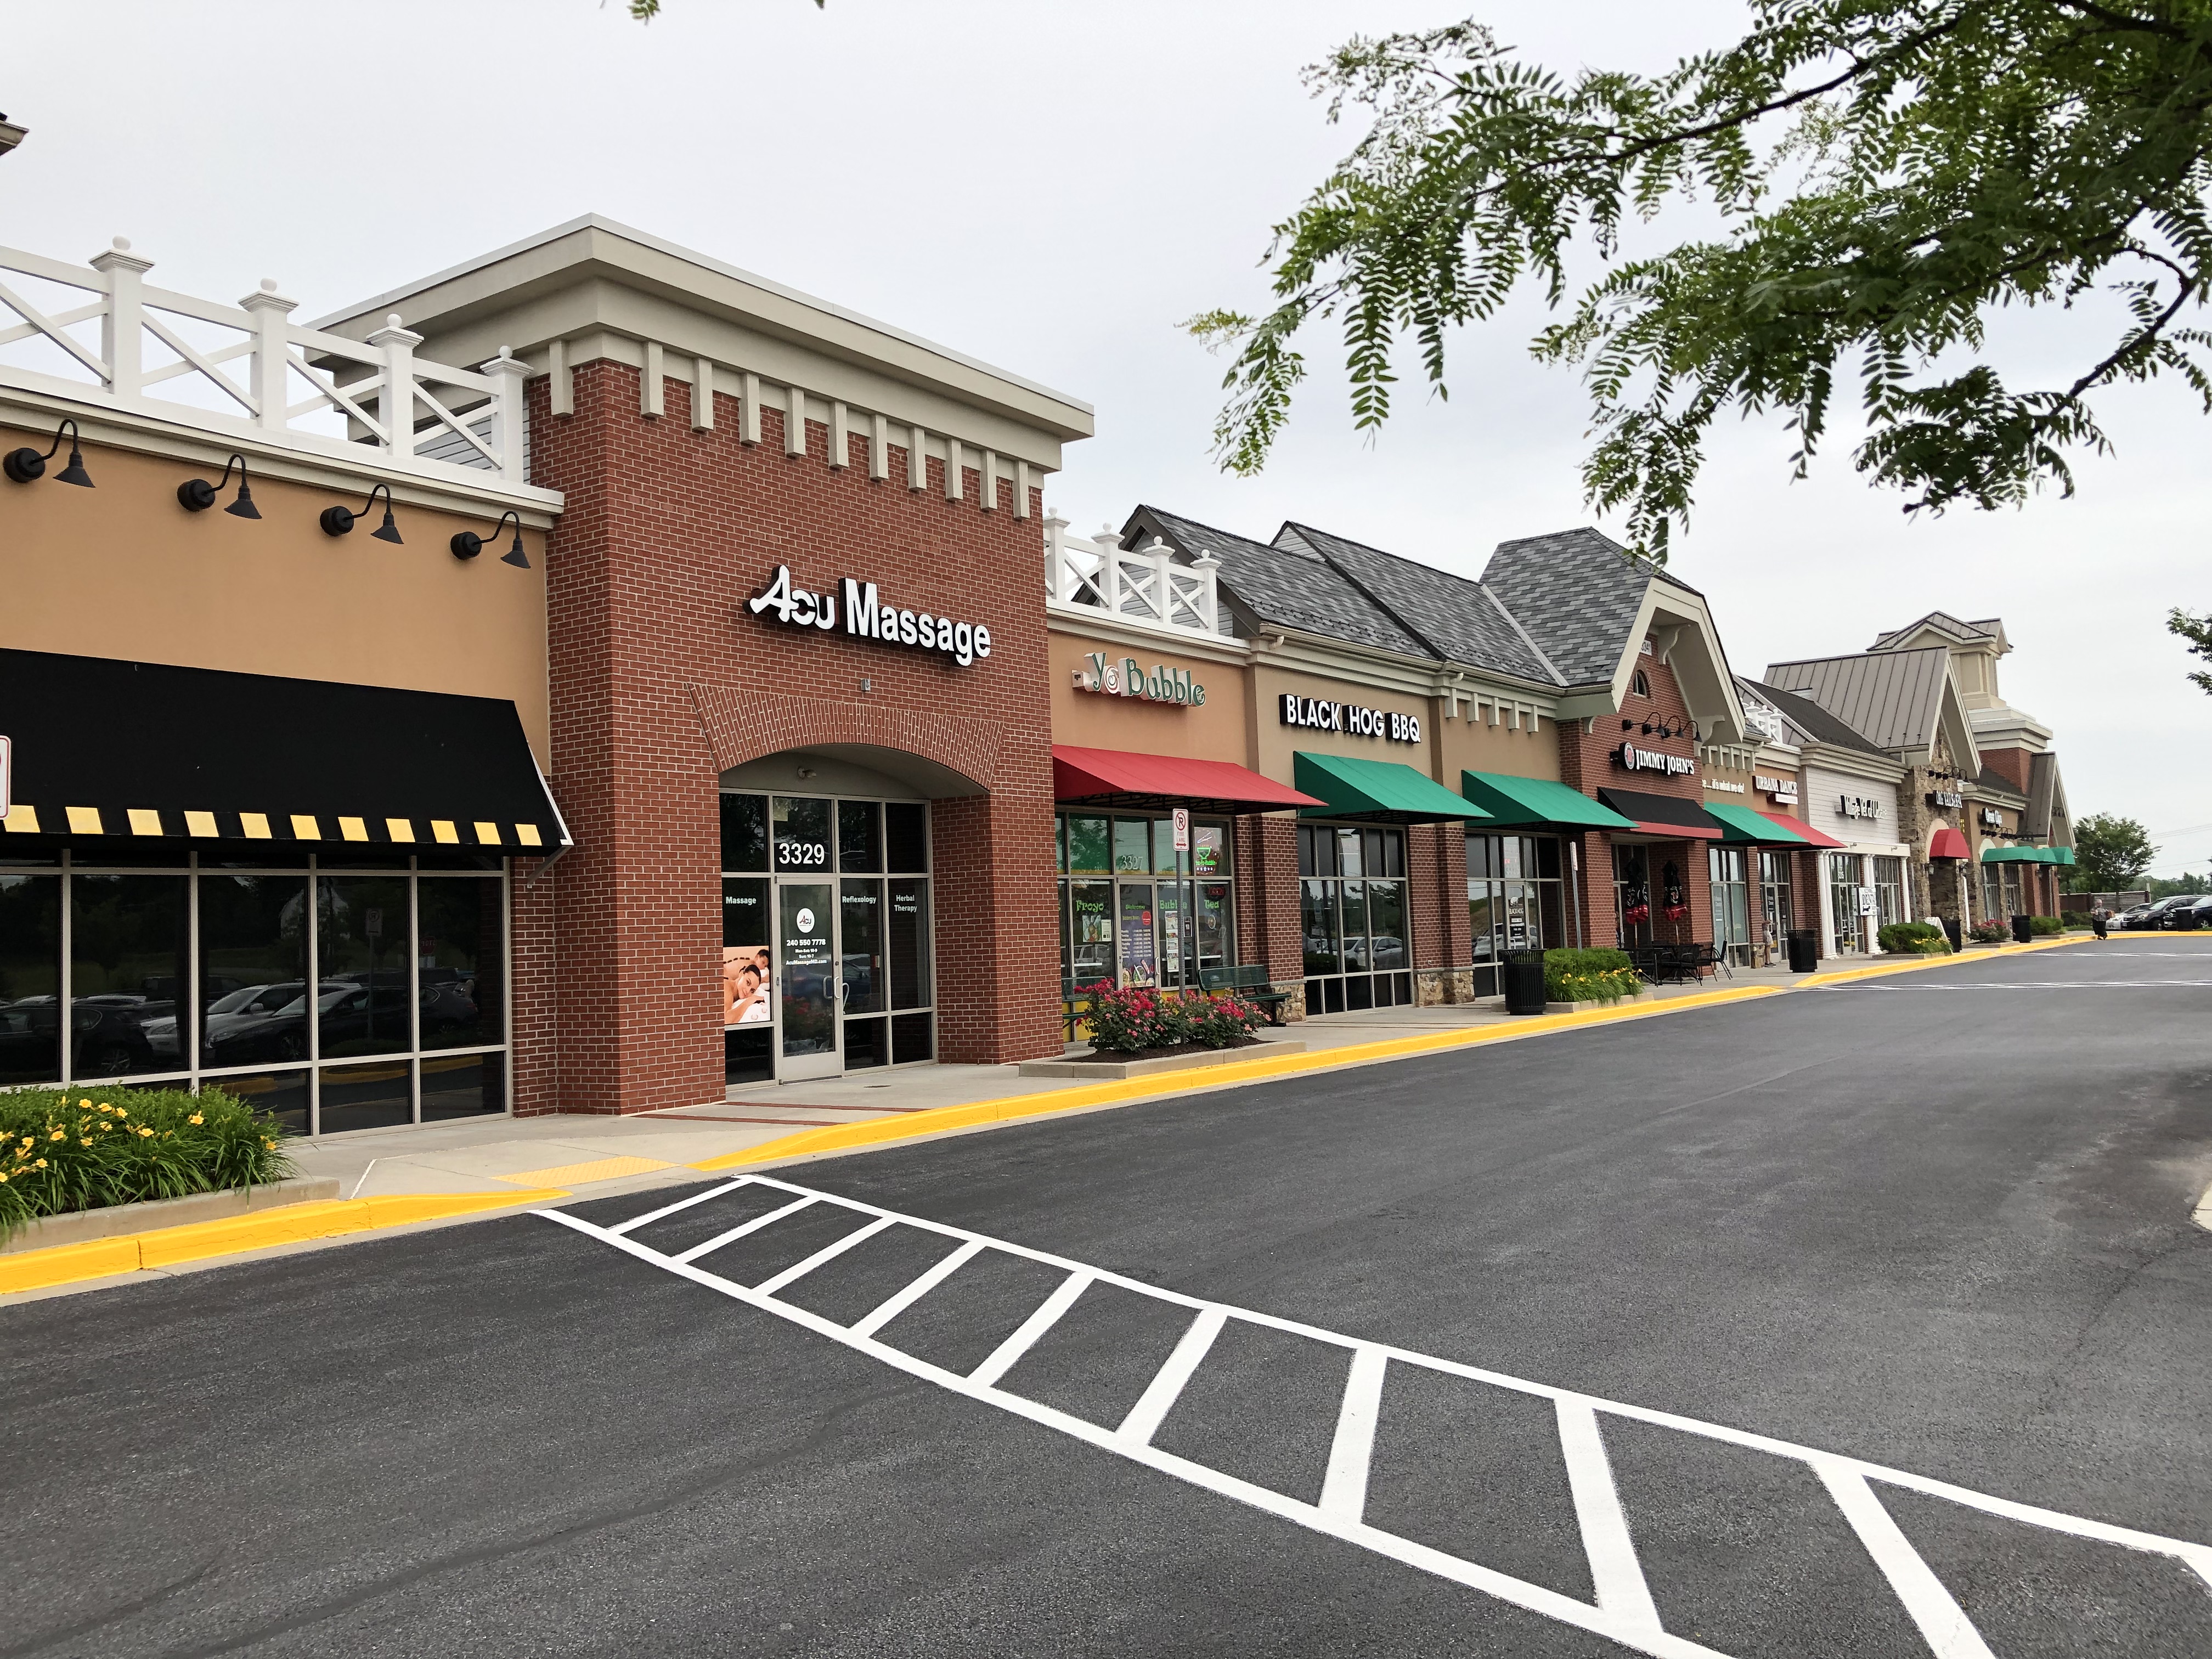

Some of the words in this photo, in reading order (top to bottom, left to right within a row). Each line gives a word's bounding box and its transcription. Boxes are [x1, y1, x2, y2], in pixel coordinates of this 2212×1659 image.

[845, 578, 991, 667] Massage
[1086, 652, 1120, 694] Yo
[1122, 657, 1206, 707] Bubble
[1285, 694, 1342, 731] BLACK
[1347, 705, 1385, 737] HOG
[1390, 712, 1421, 743] BBQ
[1635, 749, 1665, 770] JIMMY
[1666, 755, 1695, 775] JOHN'S
[1756, 775, 1779, 792] URBANA
[1779, 779, 1798, 795] DANCE
[779, 843, 825, 865] 3329
[1122, 855, 1143, 870] 3327
[725, 896, 757, 906] Massage
[842, 895, 877, 904] Reflexology
[894, 905, 917, 913] Therapy
[1076, 900, 1104, 913] Froyo
